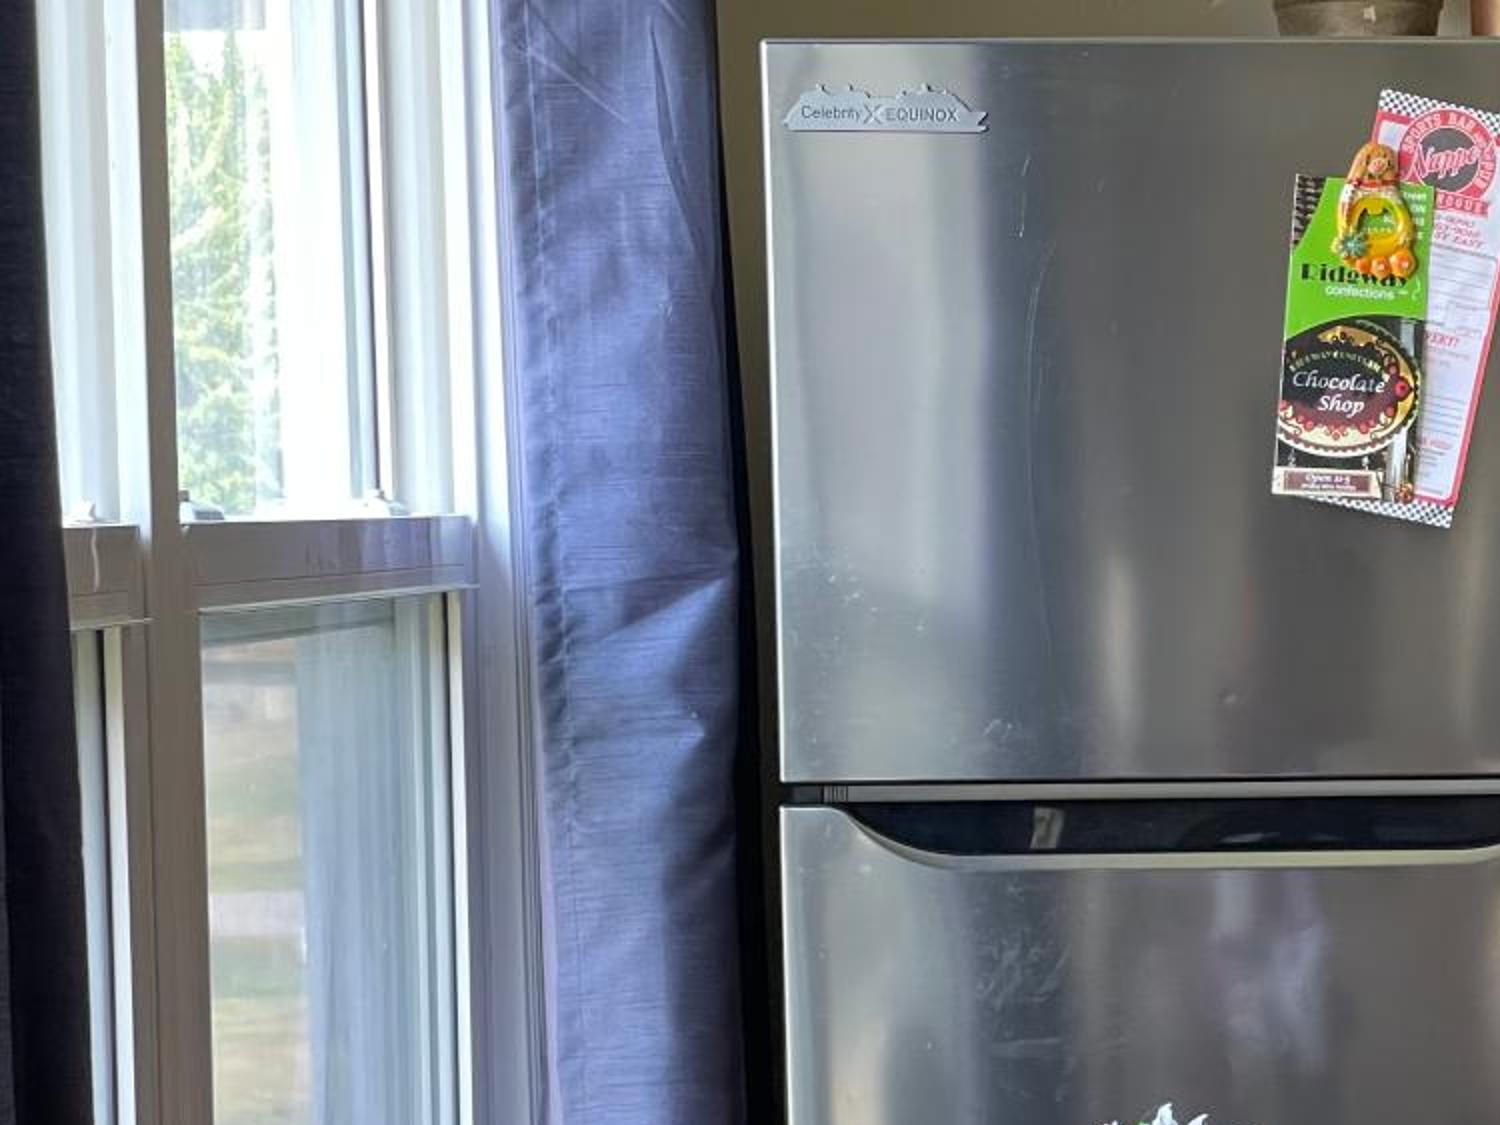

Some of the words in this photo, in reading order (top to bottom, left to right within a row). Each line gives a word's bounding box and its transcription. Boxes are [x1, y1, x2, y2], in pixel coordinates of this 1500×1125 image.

[885, 107, 959, 123] EQUINOX
[1293, 369, 1385, 393] Chocolate
[1317, 393, 1365, 418] Shop
